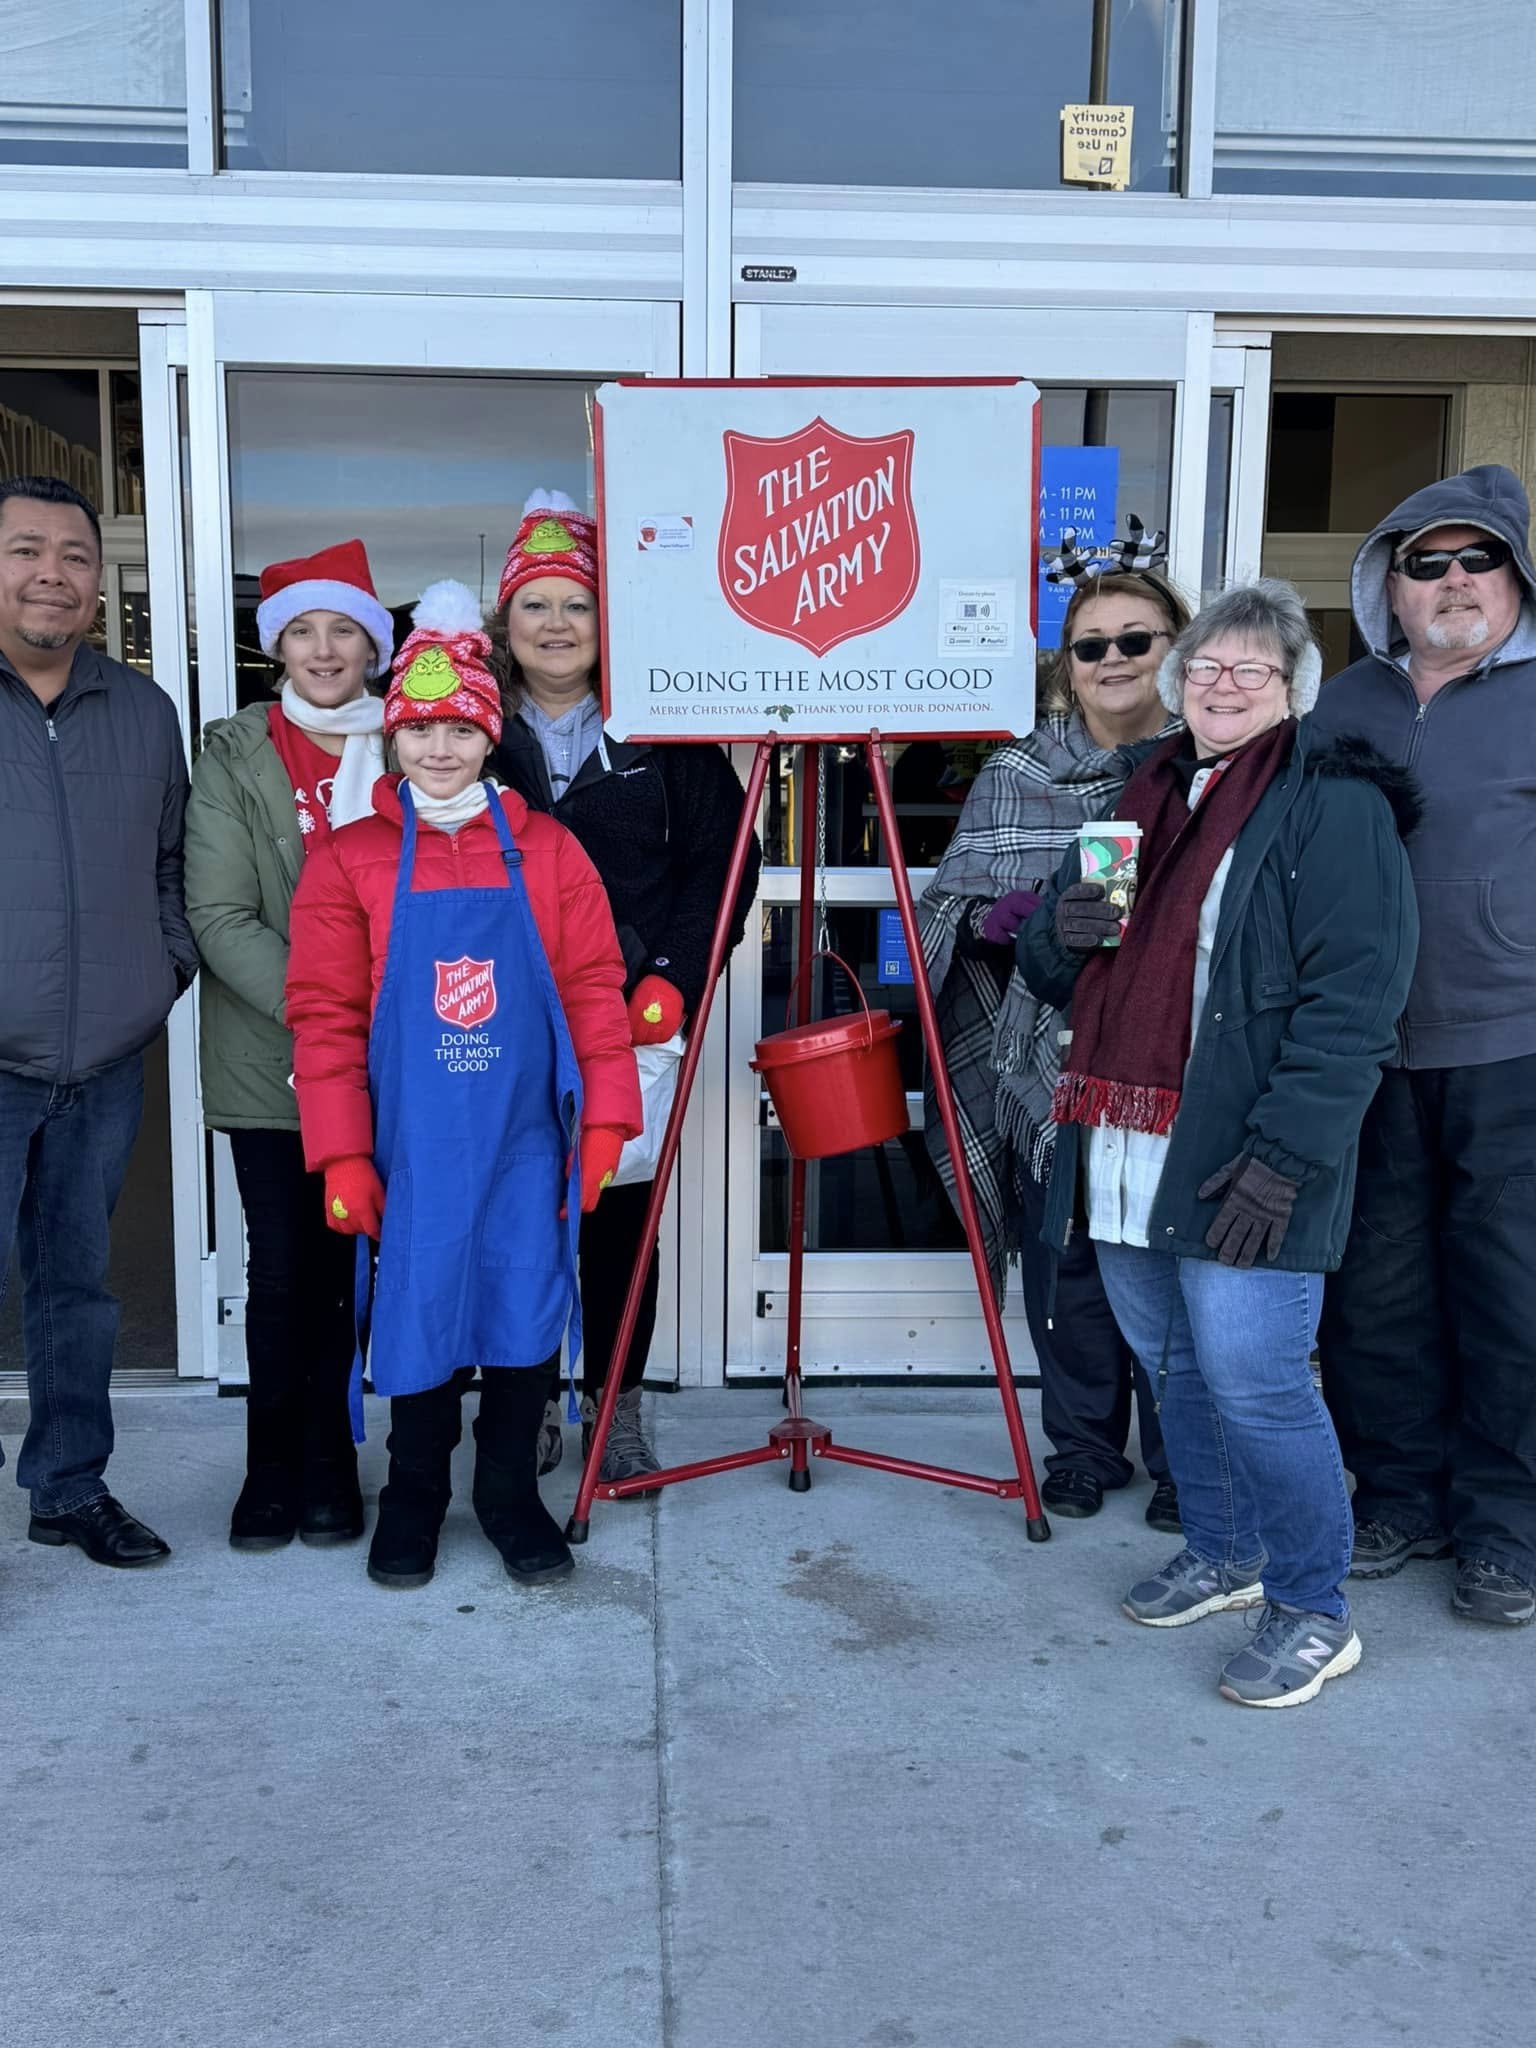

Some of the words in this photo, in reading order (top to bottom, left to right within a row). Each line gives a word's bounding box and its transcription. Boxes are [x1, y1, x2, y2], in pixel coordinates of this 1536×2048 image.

[745, 268, 793, 279] STANLEY
[758, 445, 831, 518] THE
[1061, 487, 1071, 499] 11
[1075, 487, 1096, 500] PM
[1060, 507, 1069, 520] 11
[1073, 507, 1095, 520] PM
[733, 455, 895, 596] SALVATION
[791, 521, 891, 626] ARMY
[649, 668, 748, 693] DOING
[755, 670, 809, 692] THE
[818, 669, 897, 691] MOST
[904, 668, 993, 691] GOOD
[649, 705, 689, 716] MERRY
[796, 704, 837, 715] THANK
[840, 704, 864, 714] YOU
[867, 704, 890, 714] FOR
[893, 703, 925, 713] YOUR
[446, 963, 471, 987] THE
[440, 966, 490, 1012] SALVATION
[458, 987, 490, 1020] ARMY
[442, 1033, 489, 1046] DOING
[434, 1048, 462, 1060] THE
[466, 1046, 503, 1059] MOST
[447, 1060, 489, 1073] GOOD
